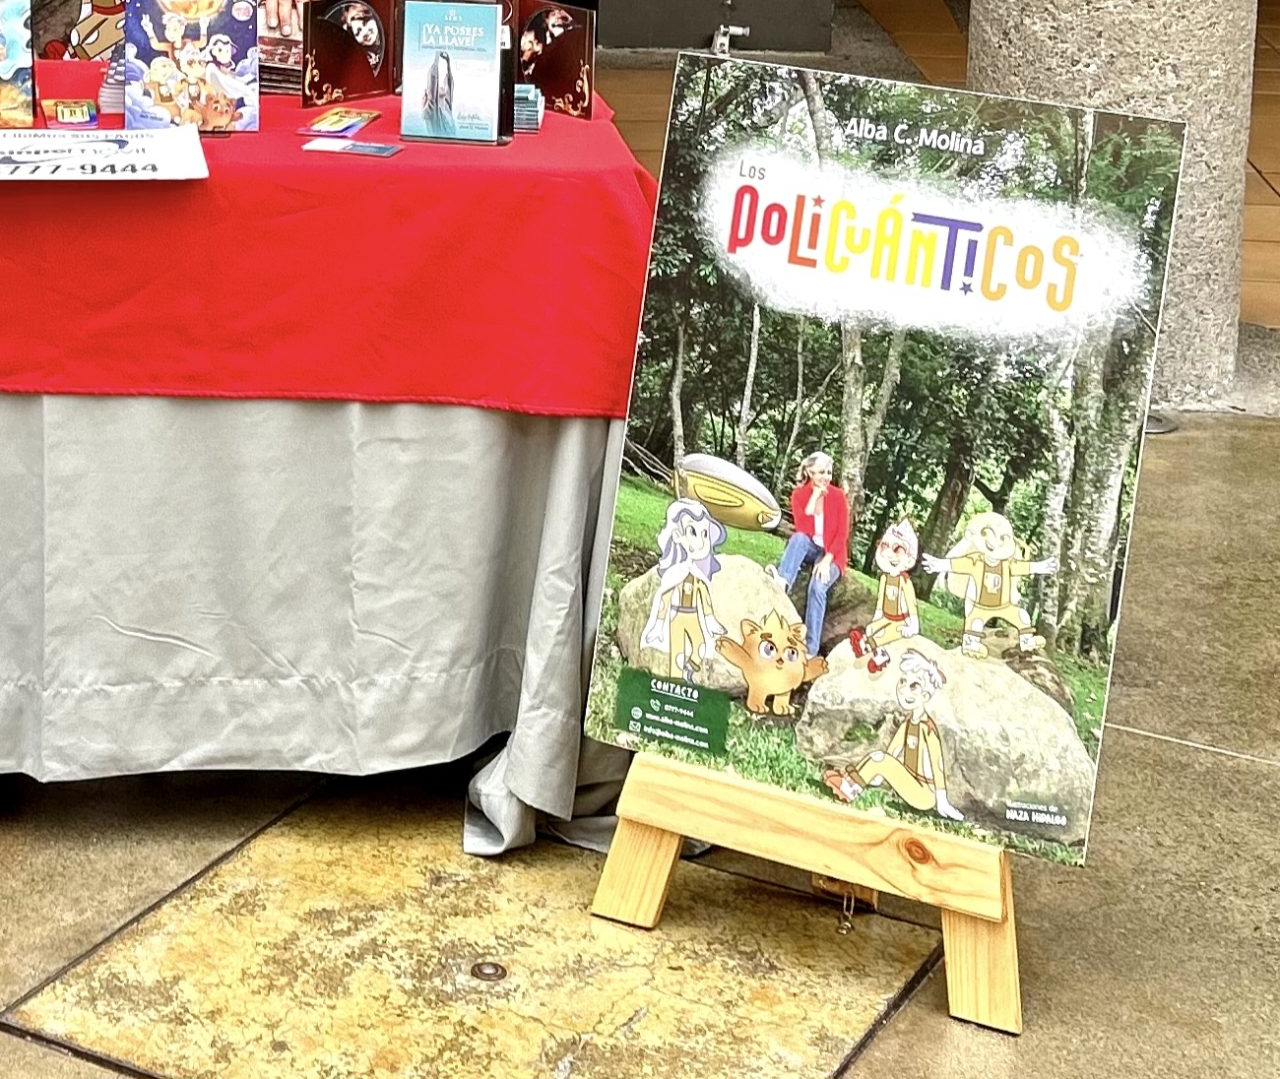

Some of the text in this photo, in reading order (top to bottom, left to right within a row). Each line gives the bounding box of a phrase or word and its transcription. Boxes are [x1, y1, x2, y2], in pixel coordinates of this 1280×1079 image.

[444, 25, 484, 37] POSEES
[844, 118, 985, 156] Alba C. Molina
[739, 160, 766, 181] Los
[650, 678, 699, 699] CONTACTO
[1006, 808, 1029, 822] NAZA
